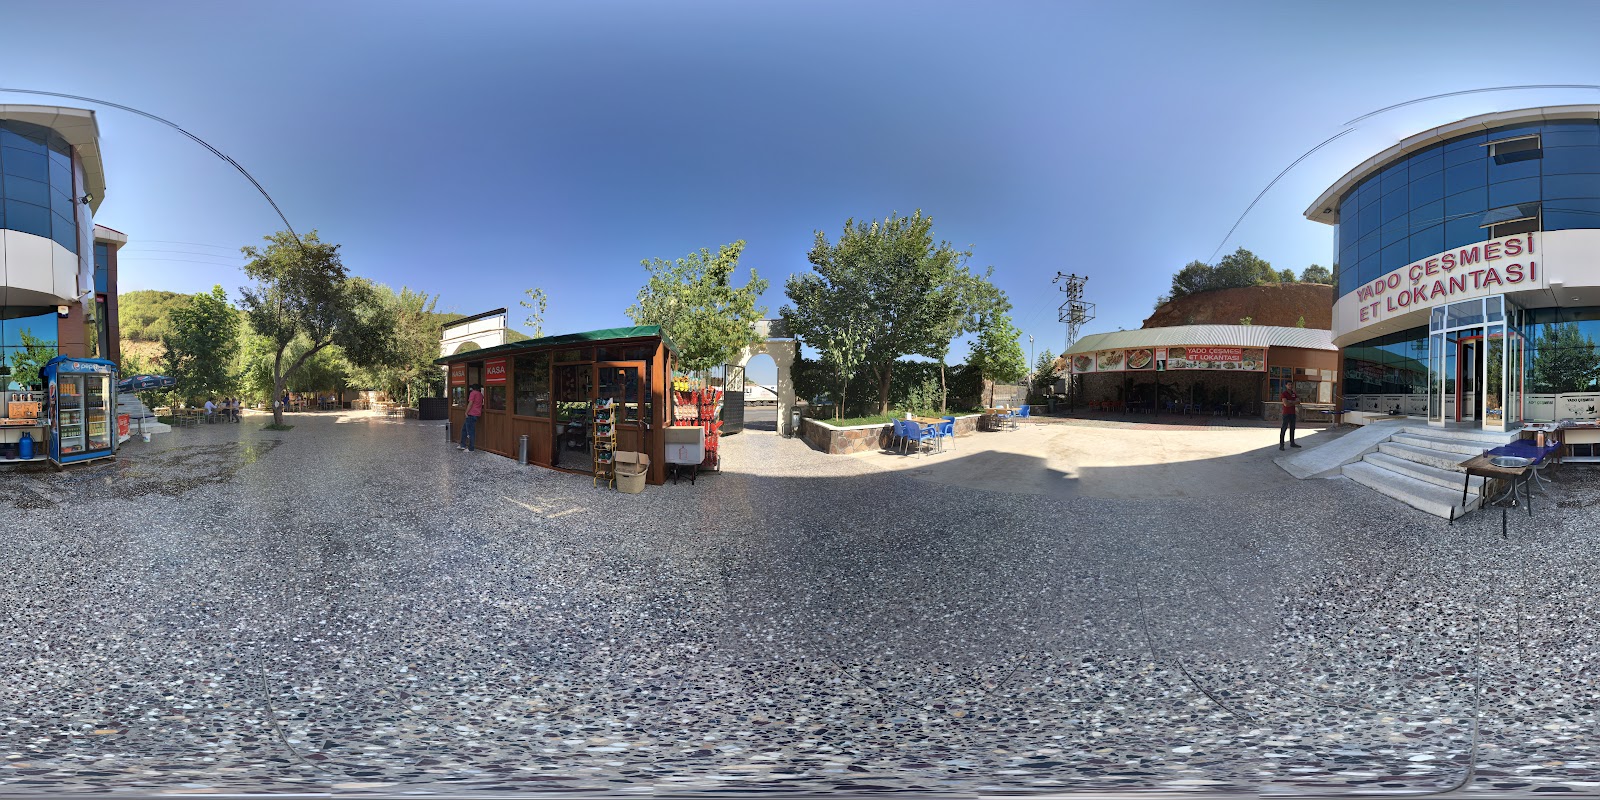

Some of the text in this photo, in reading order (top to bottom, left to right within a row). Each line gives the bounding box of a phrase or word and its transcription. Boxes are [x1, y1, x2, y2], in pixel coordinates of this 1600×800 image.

[1357, 232, 1535, 302] YADO ÇEŞMESİ
[1360, 261, 1536, 322] ET LOKANTASI
[487, 366, 506, 375] KASA
